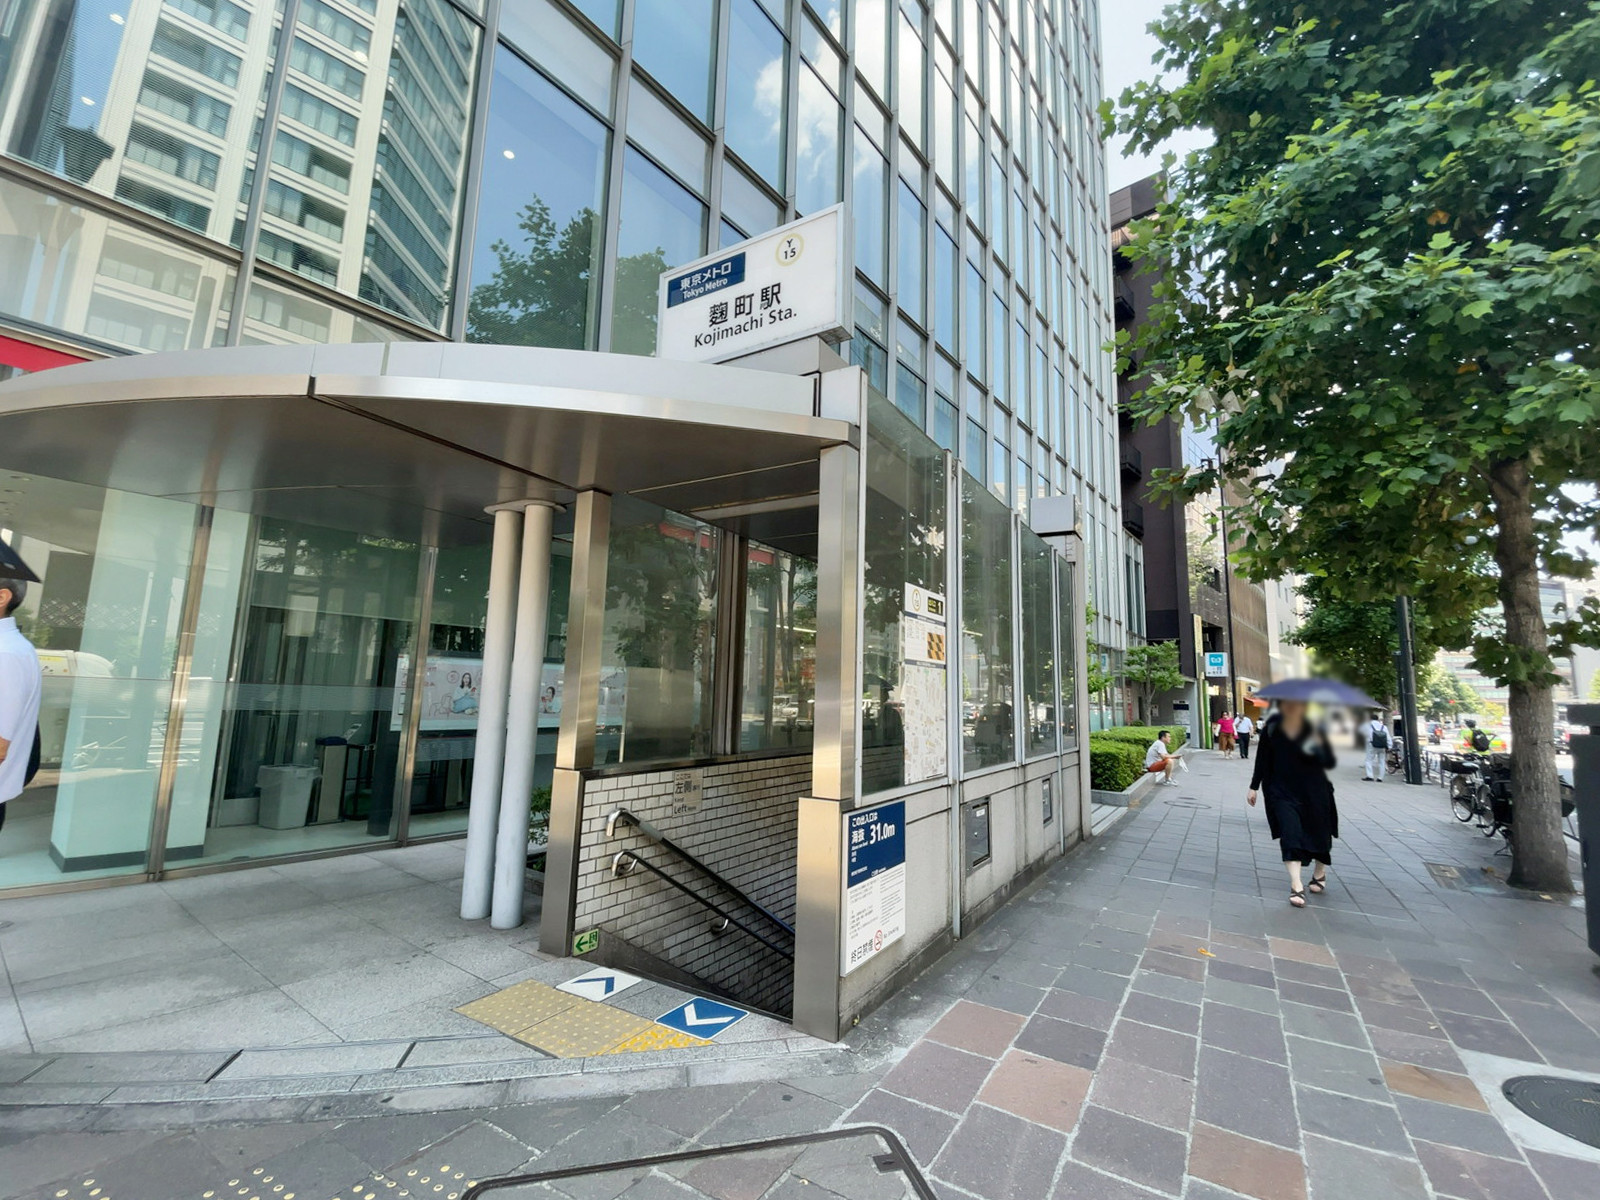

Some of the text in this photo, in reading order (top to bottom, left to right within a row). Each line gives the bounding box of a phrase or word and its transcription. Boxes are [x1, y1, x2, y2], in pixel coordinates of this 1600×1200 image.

[783, 247, 796, 260] 15
[786, 238, 793, 248] Y
[680, 261, 732, 291] 東京メトロ
[683, 277, 728, 300] Tokyo Metro
[694, 307, 797, 348] Kojimachi Sta.
[869, 822, 896, 844] 31.0m
